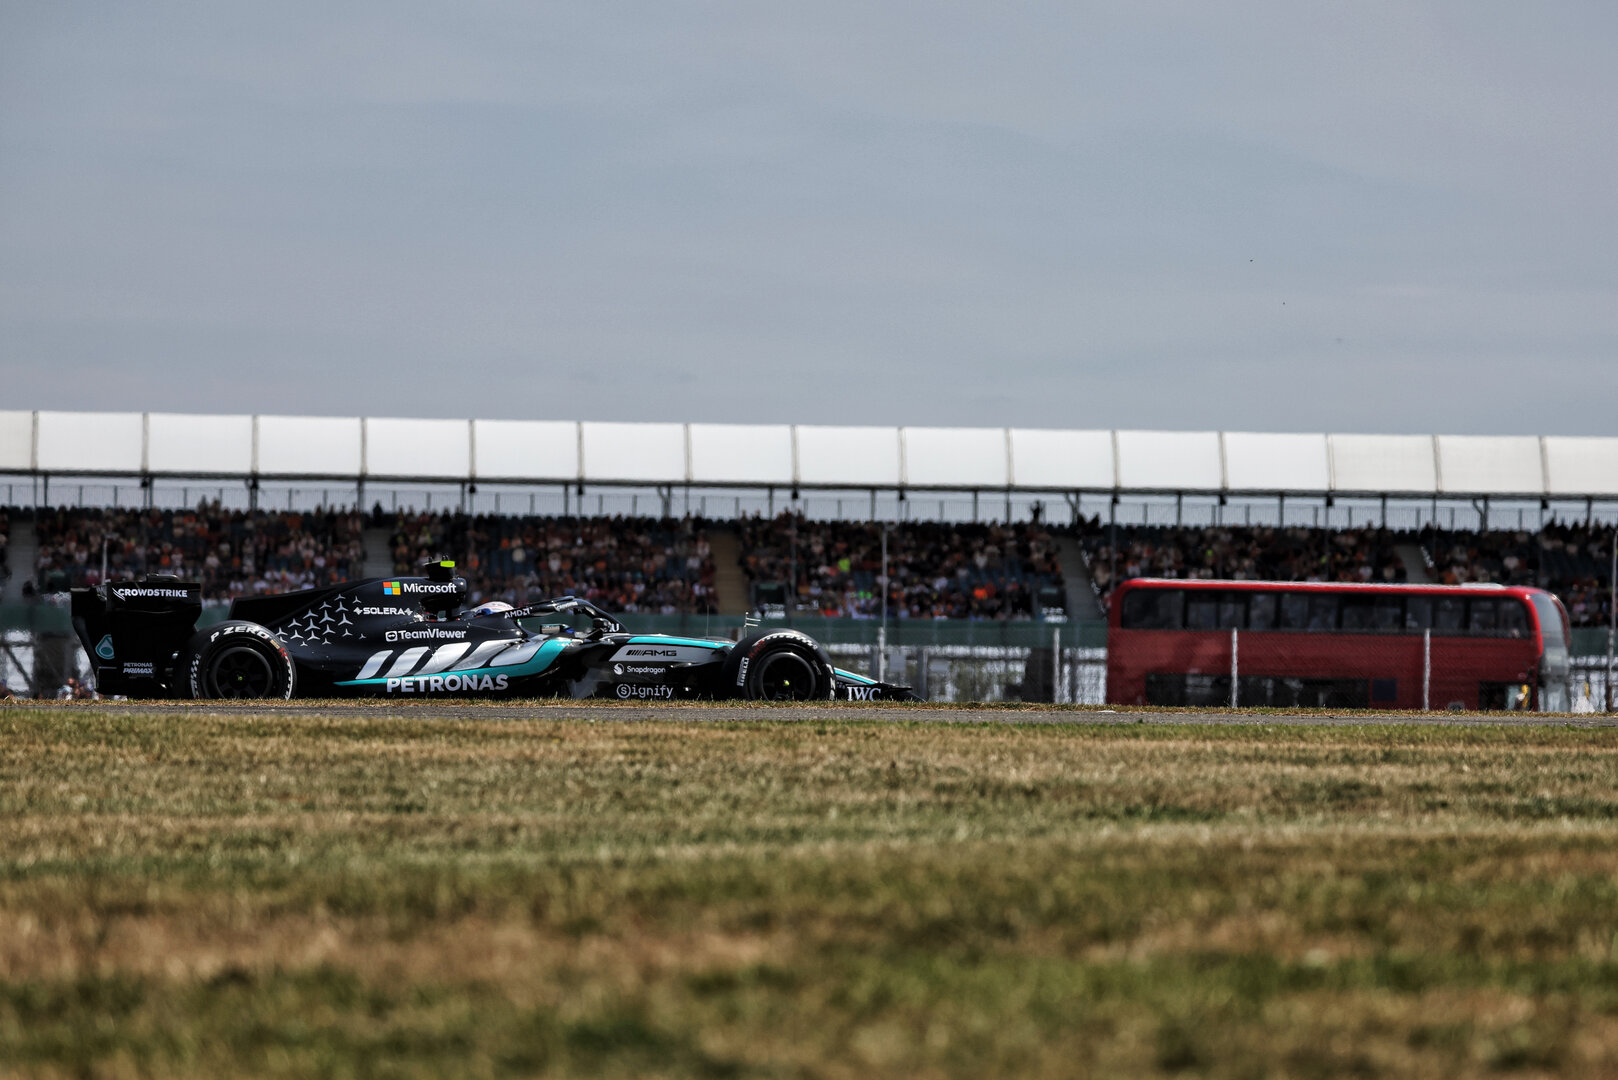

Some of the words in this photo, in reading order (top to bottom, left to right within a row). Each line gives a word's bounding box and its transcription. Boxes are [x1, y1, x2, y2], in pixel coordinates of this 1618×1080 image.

[117, 588, 188, 598] CROWDSTRIKE
[403, 582, 457, 593] Microsoft
[363, 607, 405, 616] SOLERA
[504, 608, 525, 619] AMD
[210, 631, 220, 643] P
[223, 625, 270, 641] ZERO
[398, 629, 467, 640] TeamViewer
[642, 649, 677, 657] AMG
[626, 665, 666, 675] Snapdragon
[386, 673, 509, 693] PETRONAS
[847, 686, 881, 701] IWC
